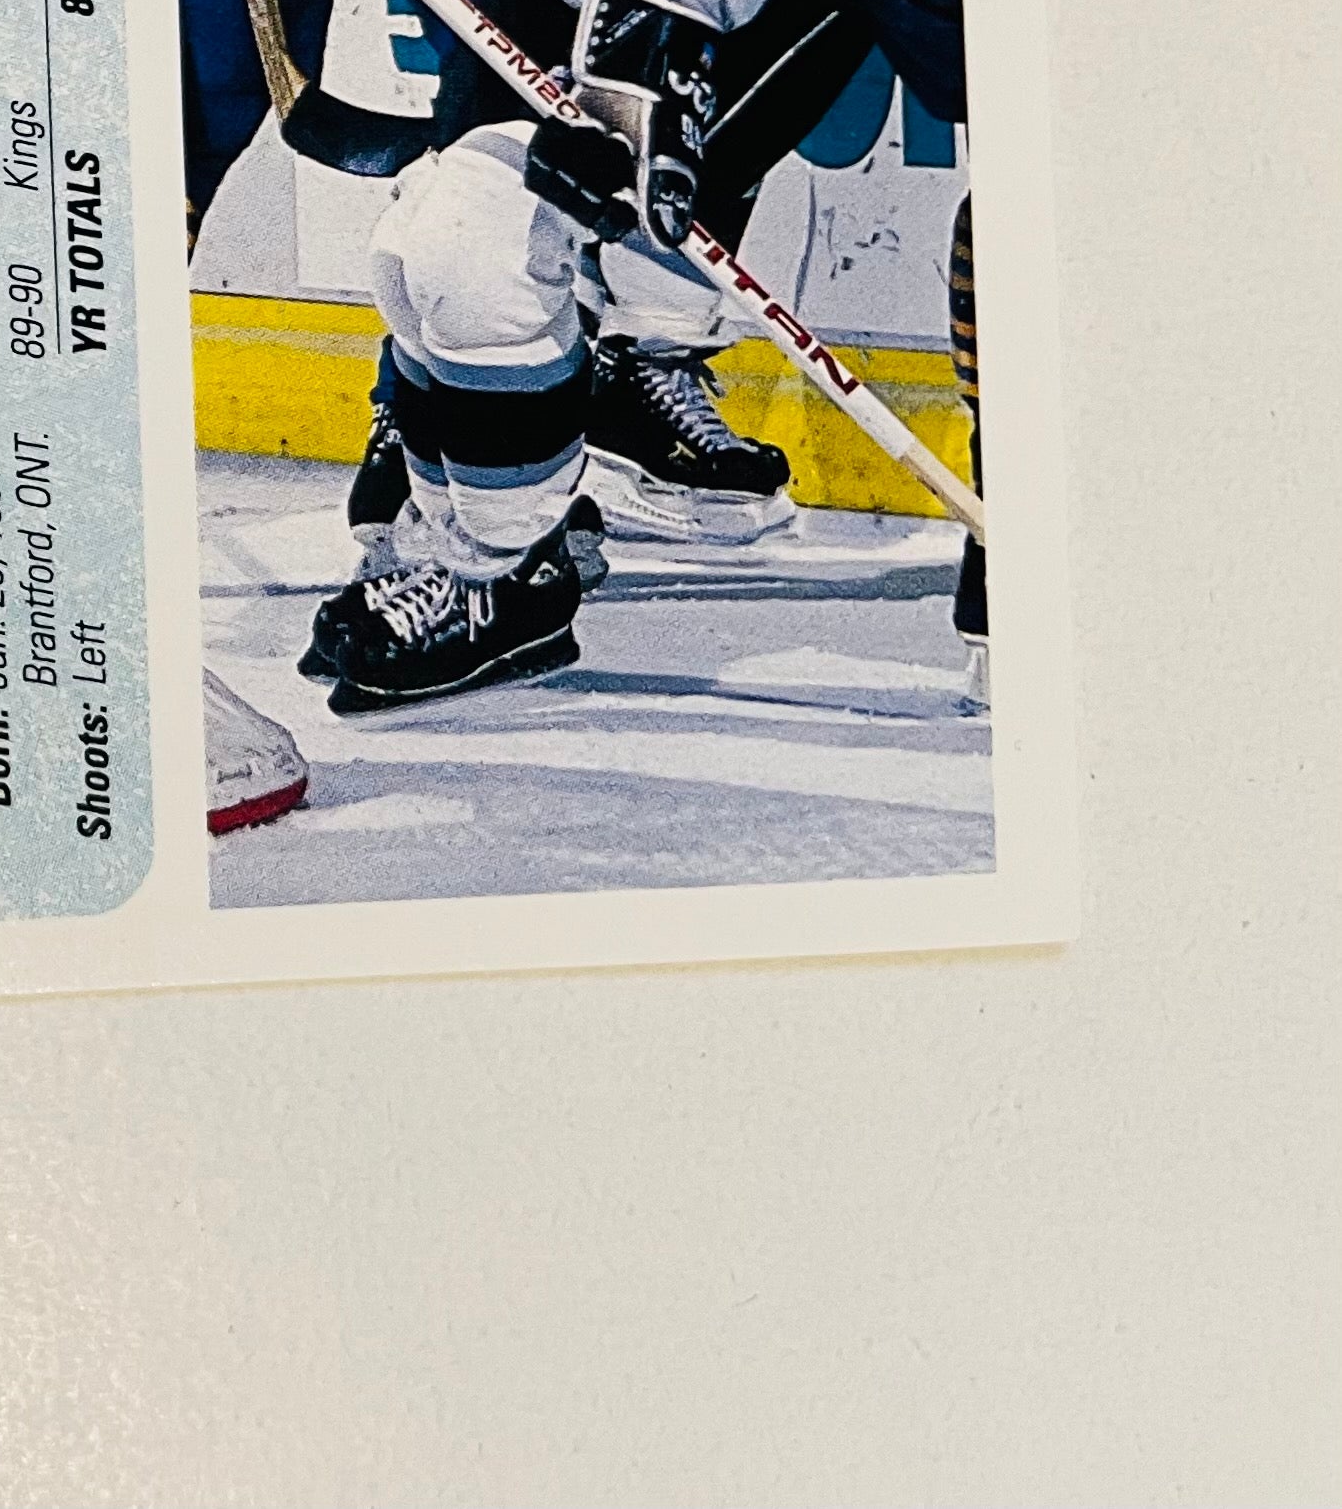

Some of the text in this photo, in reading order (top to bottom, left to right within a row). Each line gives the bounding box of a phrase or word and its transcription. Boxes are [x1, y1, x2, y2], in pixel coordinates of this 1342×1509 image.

[65, 150, 104, 292] TOTALS
[71, 305, 106, 353] YR
[14, 433, 57, 686] Brantford, ONT.
[70, 620, 111, 839] Shoots: Left
